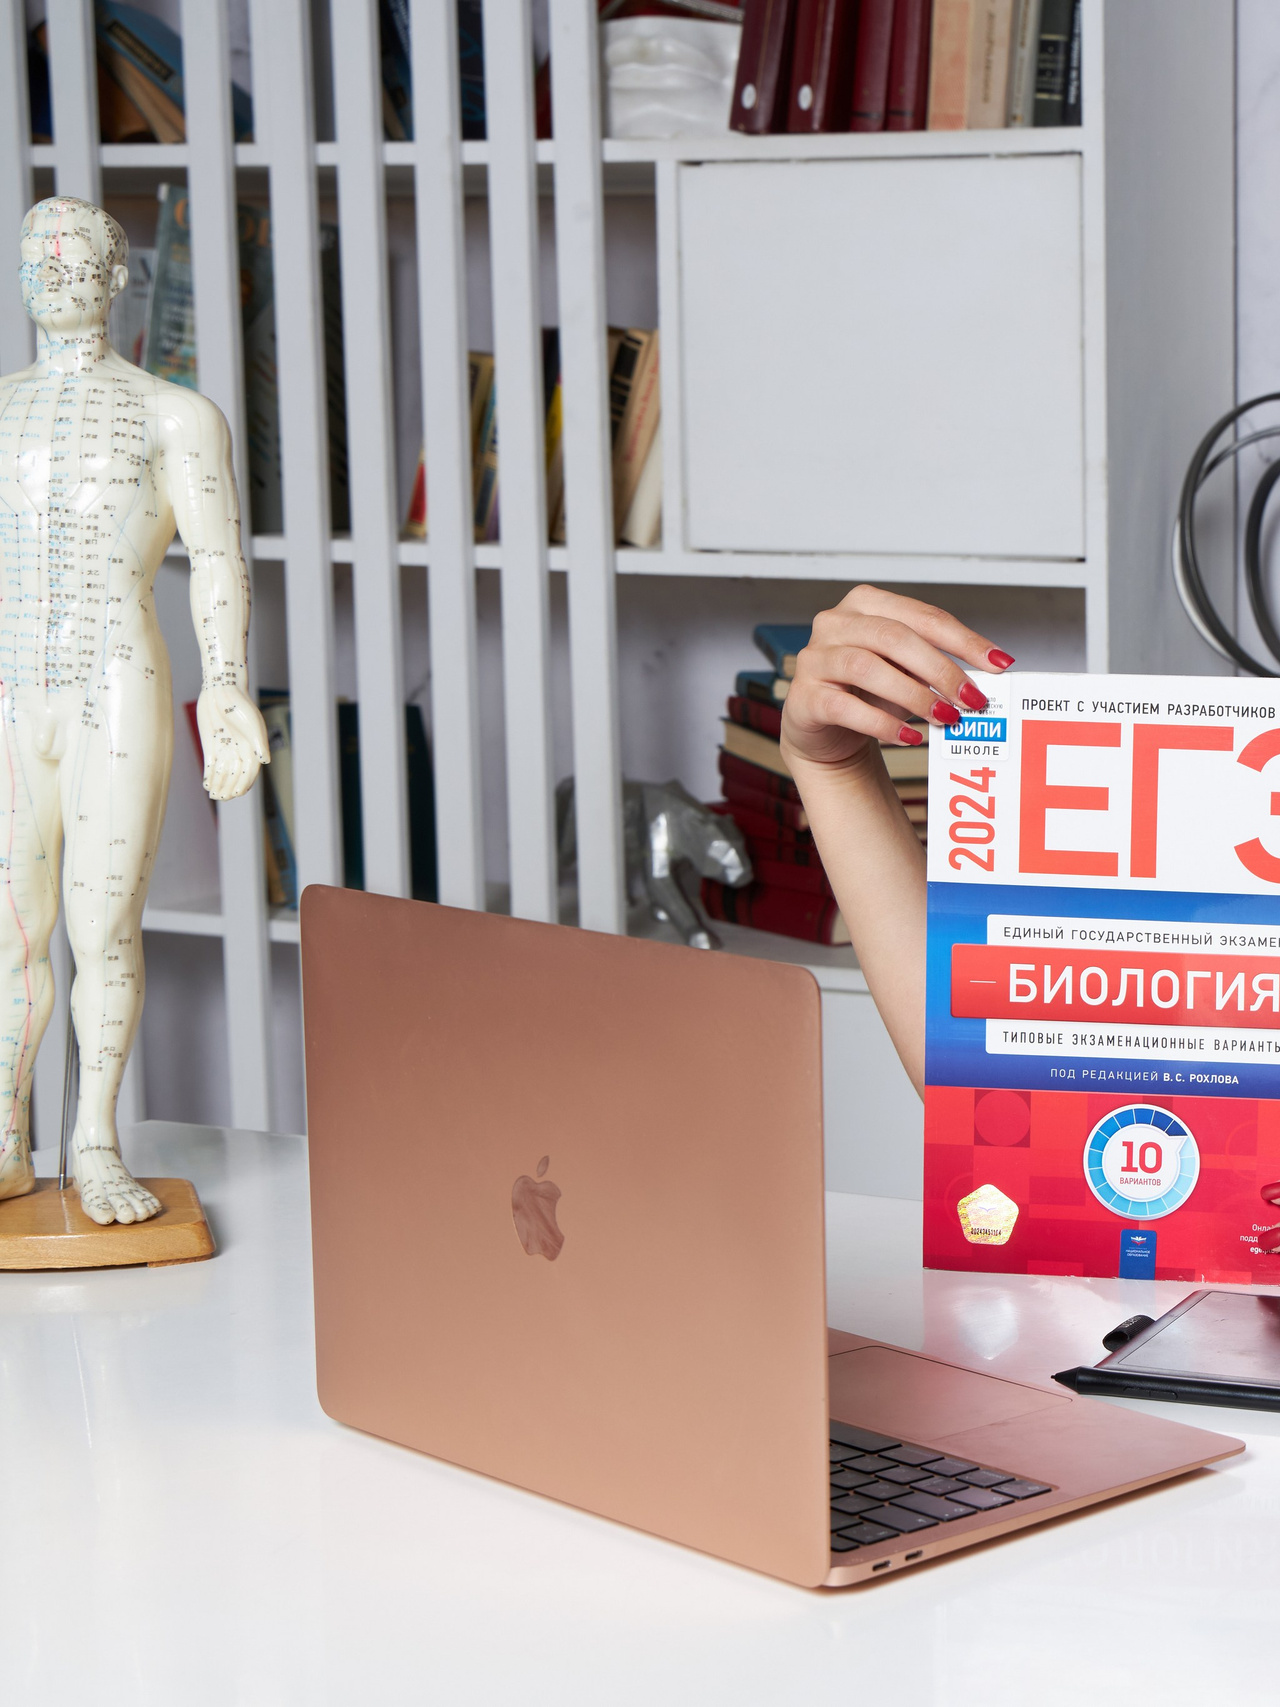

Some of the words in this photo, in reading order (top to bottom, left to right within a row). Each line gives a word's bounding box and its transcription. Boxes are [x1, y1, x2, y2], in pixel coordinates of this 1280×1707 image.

[1021, 698, 1071, 712] ПРОЕКТ
[1077, 700, 1085, 712] С
[1091, 700, 1161, 716] УЧАСТИЕМ
[1167, 703, 1277, 719] РАЗРАБОТЧИКОВ
[950, 721, 1001, 738] ФИПИ
[951, 744, 1000, 756] ШКОЛЕ
[948, 766, 996, 872] 2024
[1003, 925, 1065, 941] ЕДИНЫЙ
[1071, 928, 1213, 946] ГОСУДАРСТВЕННЫЙ
[1009, 962, 1280, 1013] БИОЛОГИЯ
[1003, 1030, 1064, 1046] ТИПОВЫЕ
[1071, 1033, 1205, 1051] ЭКЗАМЕНАЦИОННЫЕ
[1050, 1068, 1076, 1080] ПОД
[1081, 1069, 1159, 1082] РЕДАКЦИЕЙ
[1189, 1073, 1240, 1085] РОХЛОВА
[1120, 1140, 1163, 1174] 10
[1119, 1177, 1162, 1187] ВАРИАНТОВ
